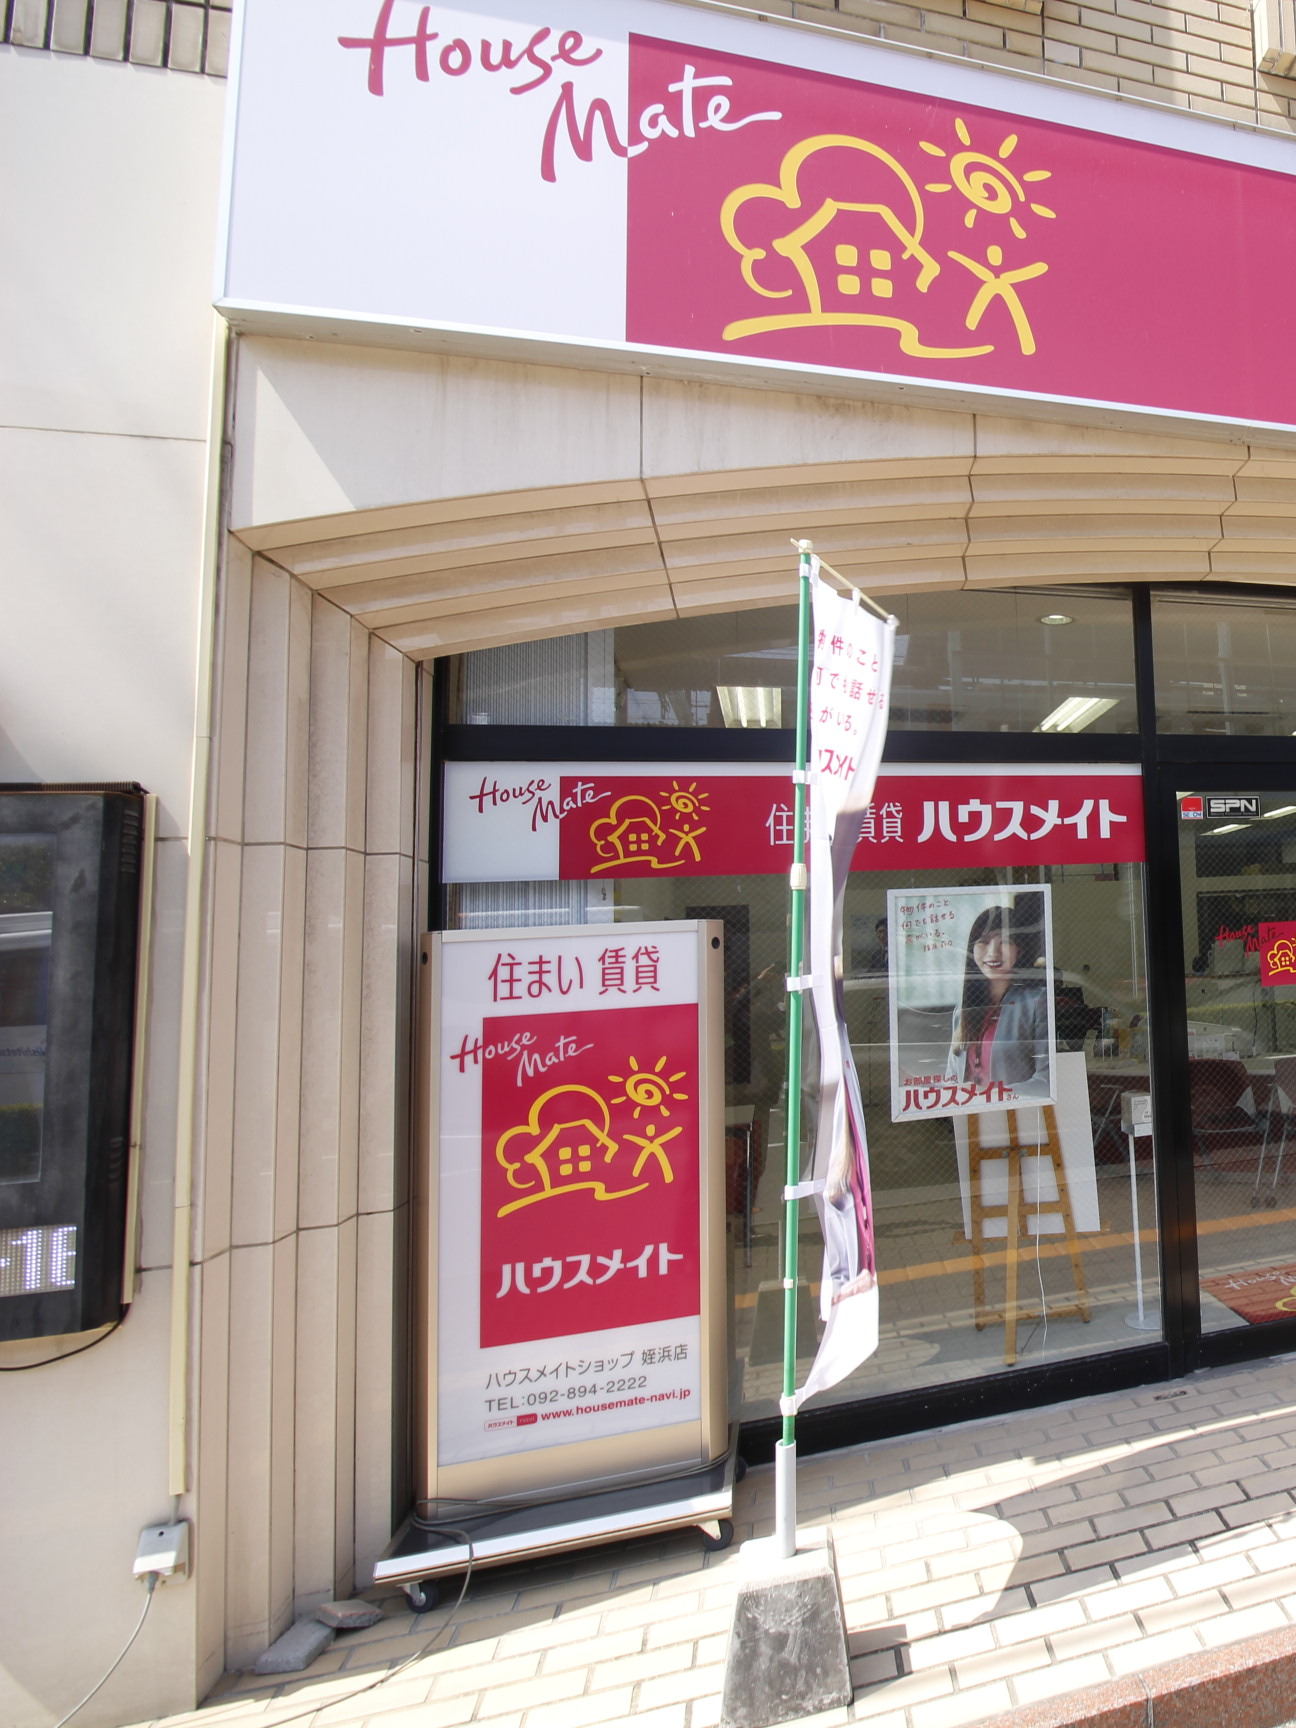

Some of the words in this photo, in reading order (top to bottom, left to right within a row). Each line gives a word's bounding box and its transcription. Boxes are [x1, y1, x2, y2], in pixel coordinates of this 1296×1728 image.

[338, 0, 603, 97] House
[540, 64, 783, 183] Mate
[469, 776, 551, 813] House
[531, 781, 612, 832] Mate
[1210, 799, 1257, 813] SPN
[917, 798, 1128, 843] ハウスメイト
[1215, 924, 1255, 949] House
[1245, 926, 1285, 958] Mate
[487, 953, 584, 1003] 住まい
[598, 945, 661, 995] 賃貸
[449, 1032, 538, 1074] House
[516, 1035, 595, 1088] Mate
[902, 1080, 1013, 1112] ハウスメイト
[904, 1074, 958, 1086] お部屋探しの
[496, 1243, 684, 1299] ハウスメイト
[485, 1351, 636, 1390] ハウスメイトショップ
[641, 1344, 689, 1367] 姪浜店
[484, 1375, 648, 1413] TEL:092-894-2222
[540, 1388, 692, 1422] www.housemate-navi.jp
